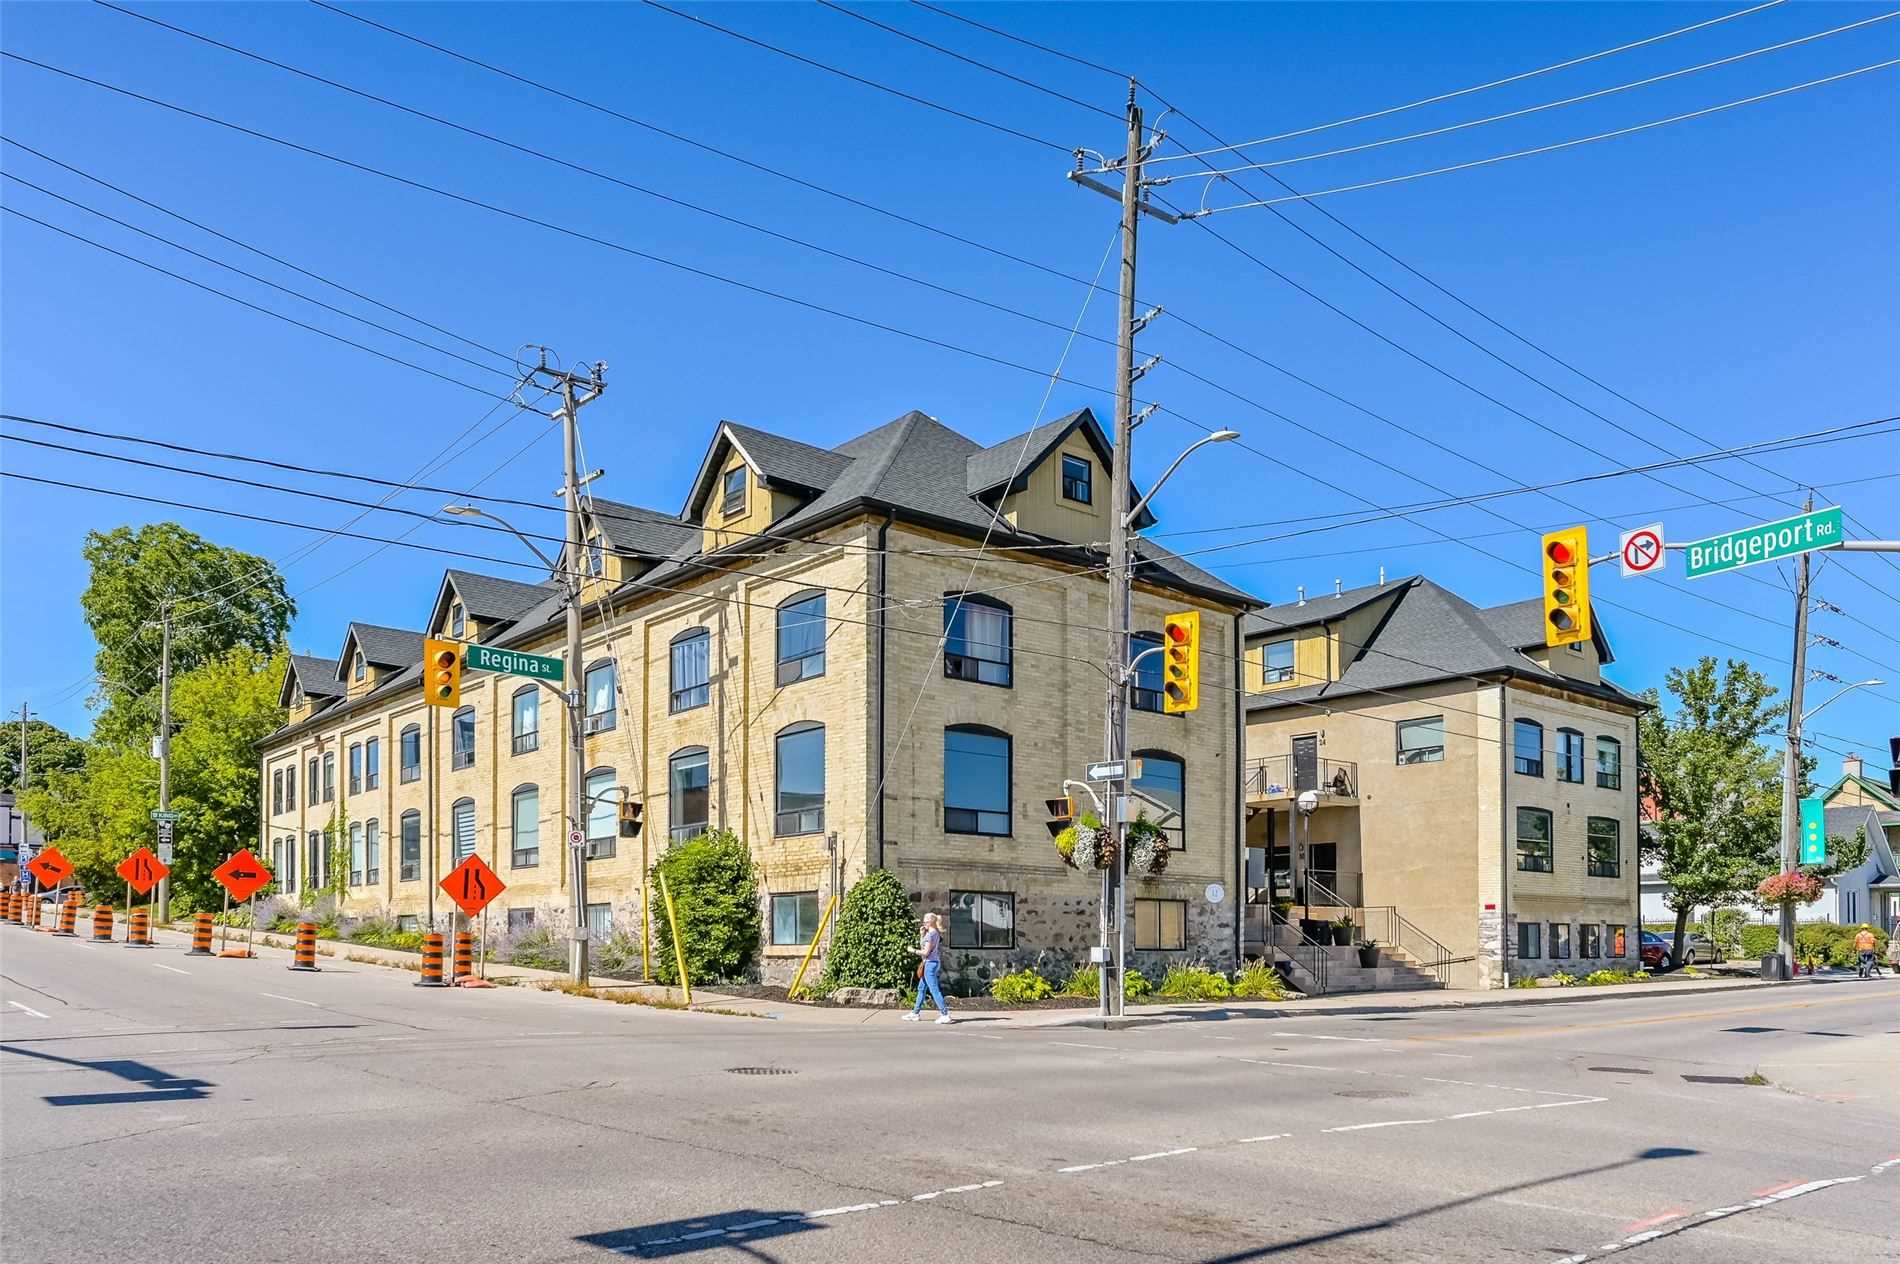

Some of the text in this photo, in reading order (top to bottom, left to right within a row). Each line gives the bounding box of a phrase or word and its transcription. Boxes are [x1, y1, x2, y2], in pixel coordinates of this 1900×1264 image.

[1690, 518, 1836, 570] Bridgeport Rd.
[480, 649, 552, 673] Regina St.
